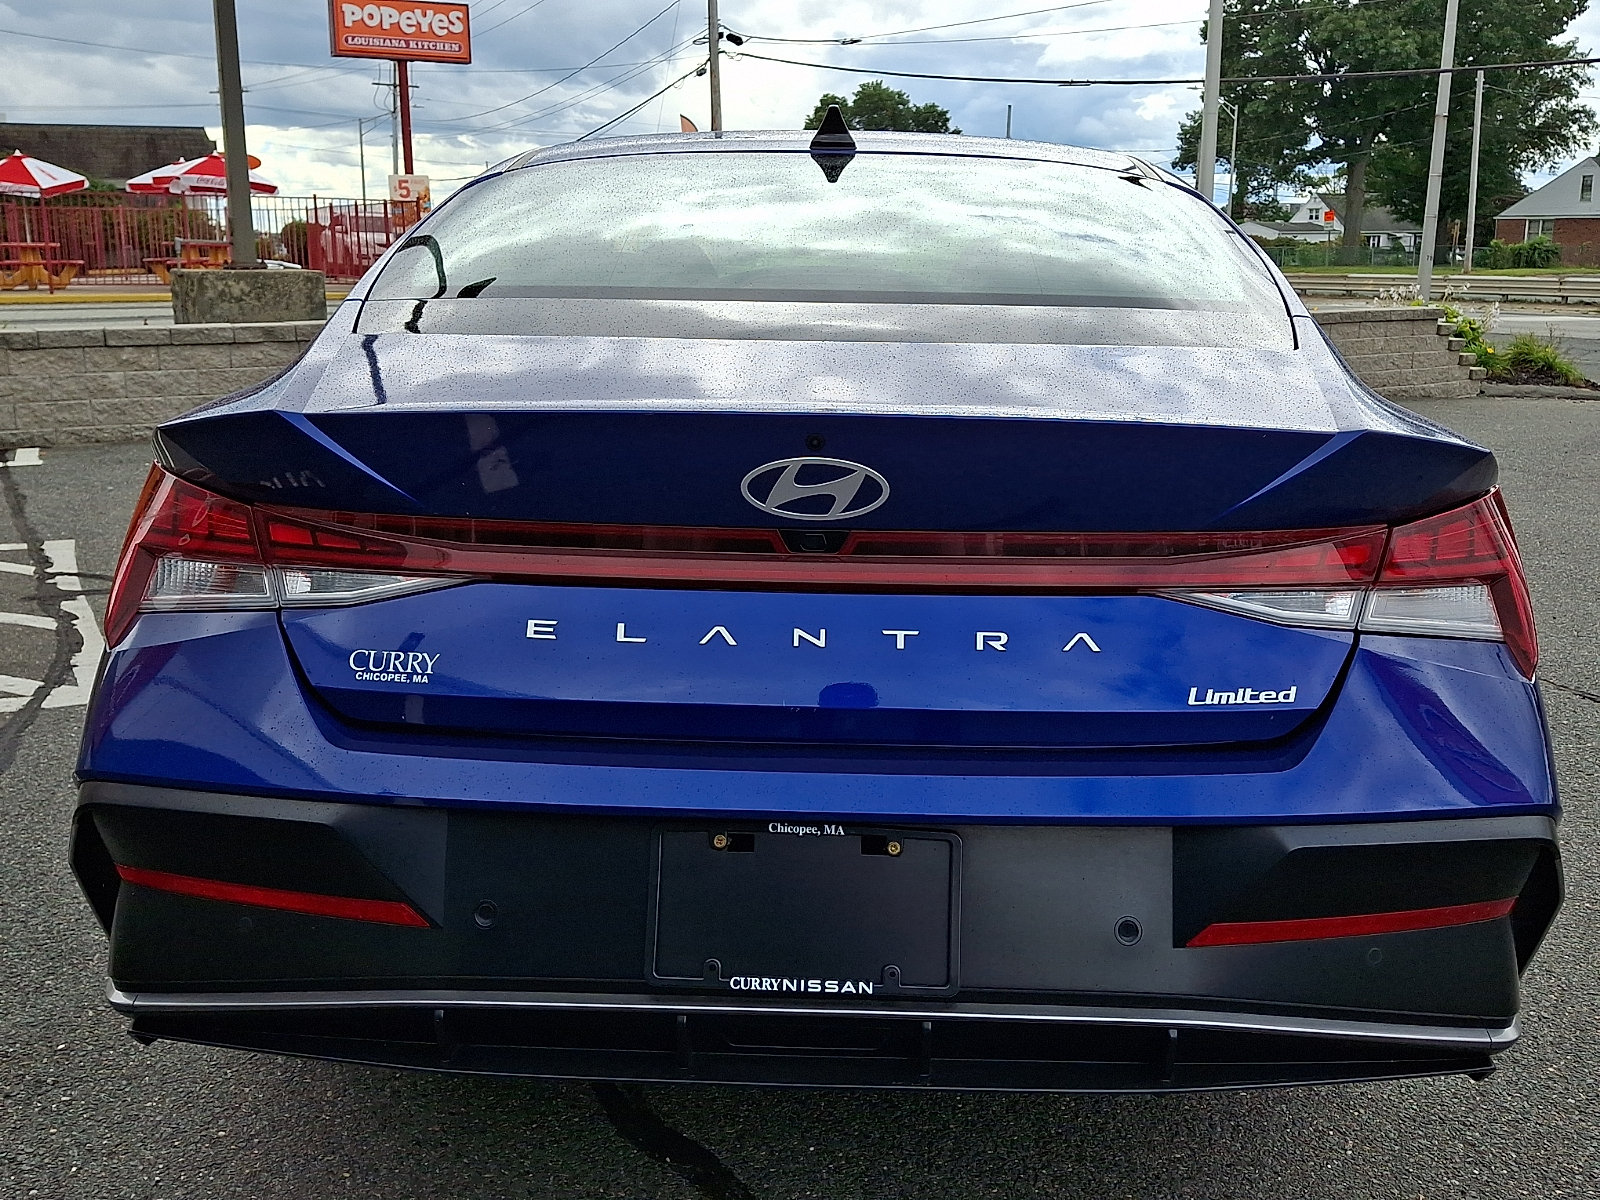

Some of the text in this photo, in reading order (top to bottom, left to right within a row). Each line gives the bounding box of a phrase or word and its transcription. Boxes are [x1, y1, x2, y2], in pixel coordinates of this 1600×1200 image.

[347, 36, 460, 51] LOUISIANA KITCHEN
[526, 619, 1101, 652] ELANTRA
[349, 649, 440, 674] CURRY
[355, 672, 429, 683] CHICOPEE, MA
[1187, 685, 1297, 706] Limited
[768, 822, 845, 836] Chicopee, MA
